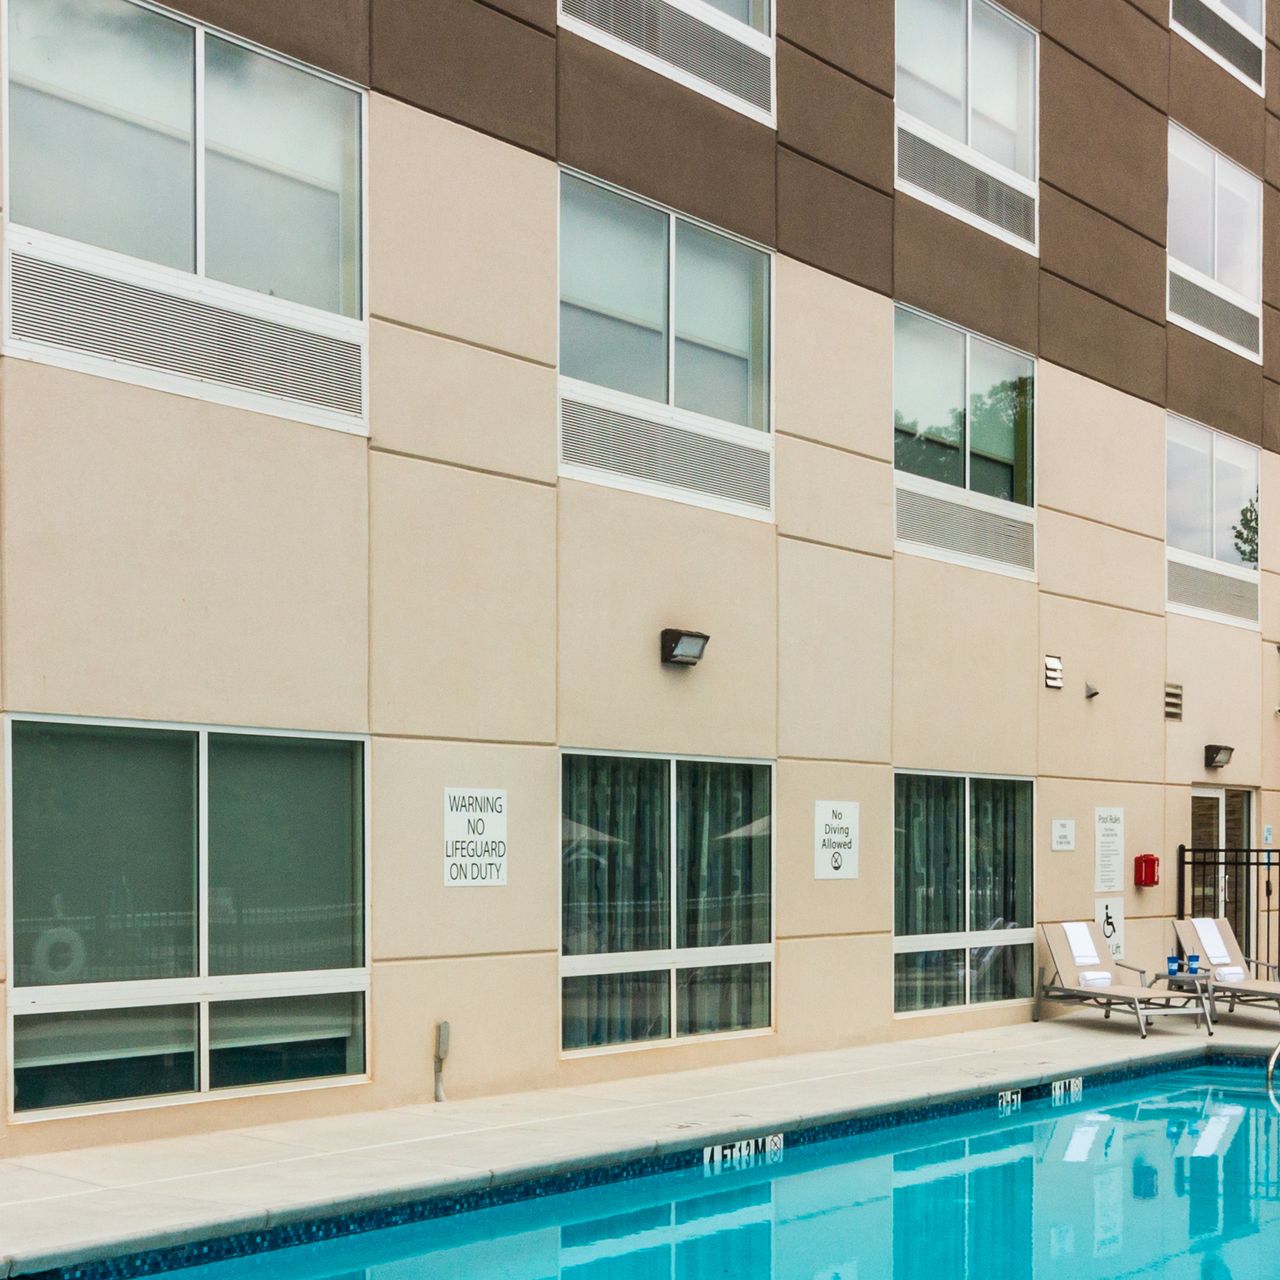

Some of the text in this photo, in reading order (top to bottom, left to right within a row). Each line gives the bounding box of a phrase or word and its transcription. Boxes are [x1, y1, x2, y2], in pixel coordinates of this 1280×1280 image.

[448, 794, 503, 814] WARNING
[831, 809, 843, 820] No
[467, 818, 485, 836] NO
[824, 823, 849, 838] Diving
[445, 840, 506, 858] LIFEGUARD
[821, 838, 852, 849] Allowed
[449, 863, 502, 880] ON DUTY
